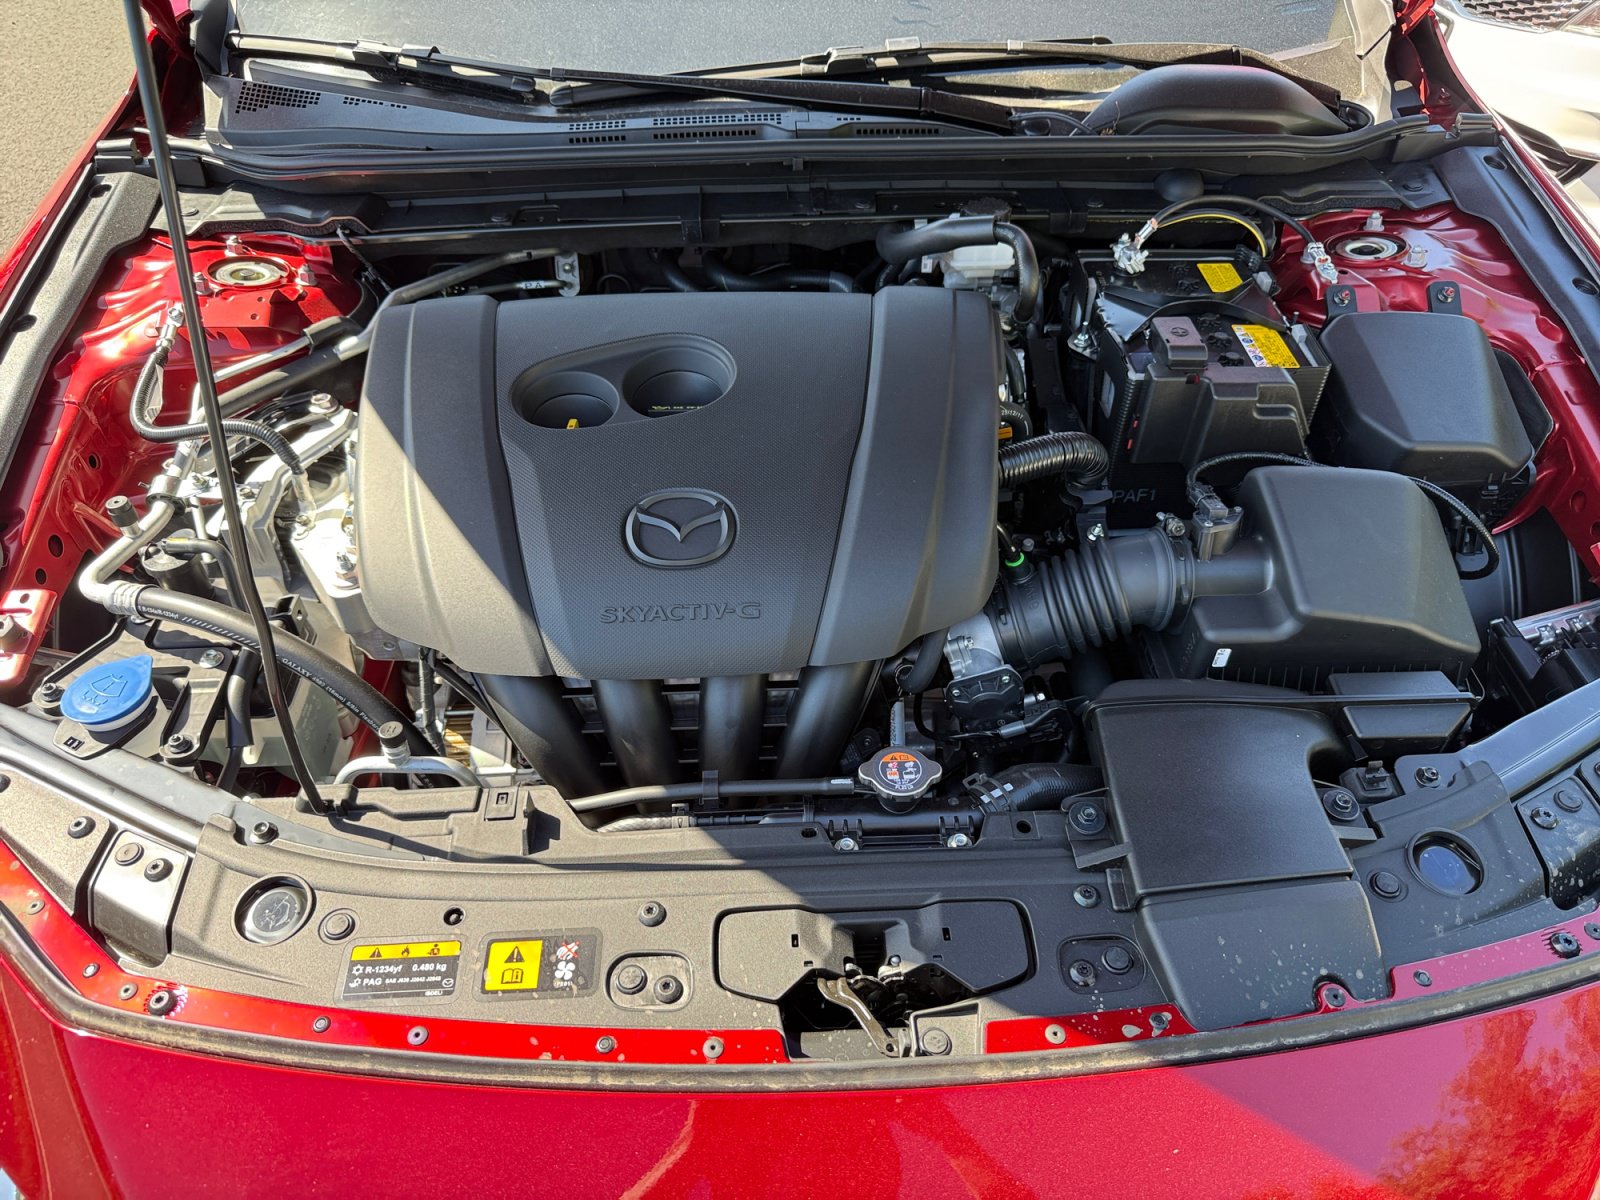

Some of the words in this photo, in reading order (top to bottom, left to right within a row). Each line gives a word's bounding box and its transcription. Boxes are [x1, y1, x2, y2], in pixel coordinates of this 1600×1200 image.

[1112, 488, 1156, 503] PAF1
[600, 601, 761, 624] SKYACTIV-G
[282, 658, 312, 678] GALAXY
[365, 964, 402, 974] R-1234yf
[412, 963, 434, 972] 0.480
[436, 962, 447, 972] kg
[362, 978, 382, 986] PAG
